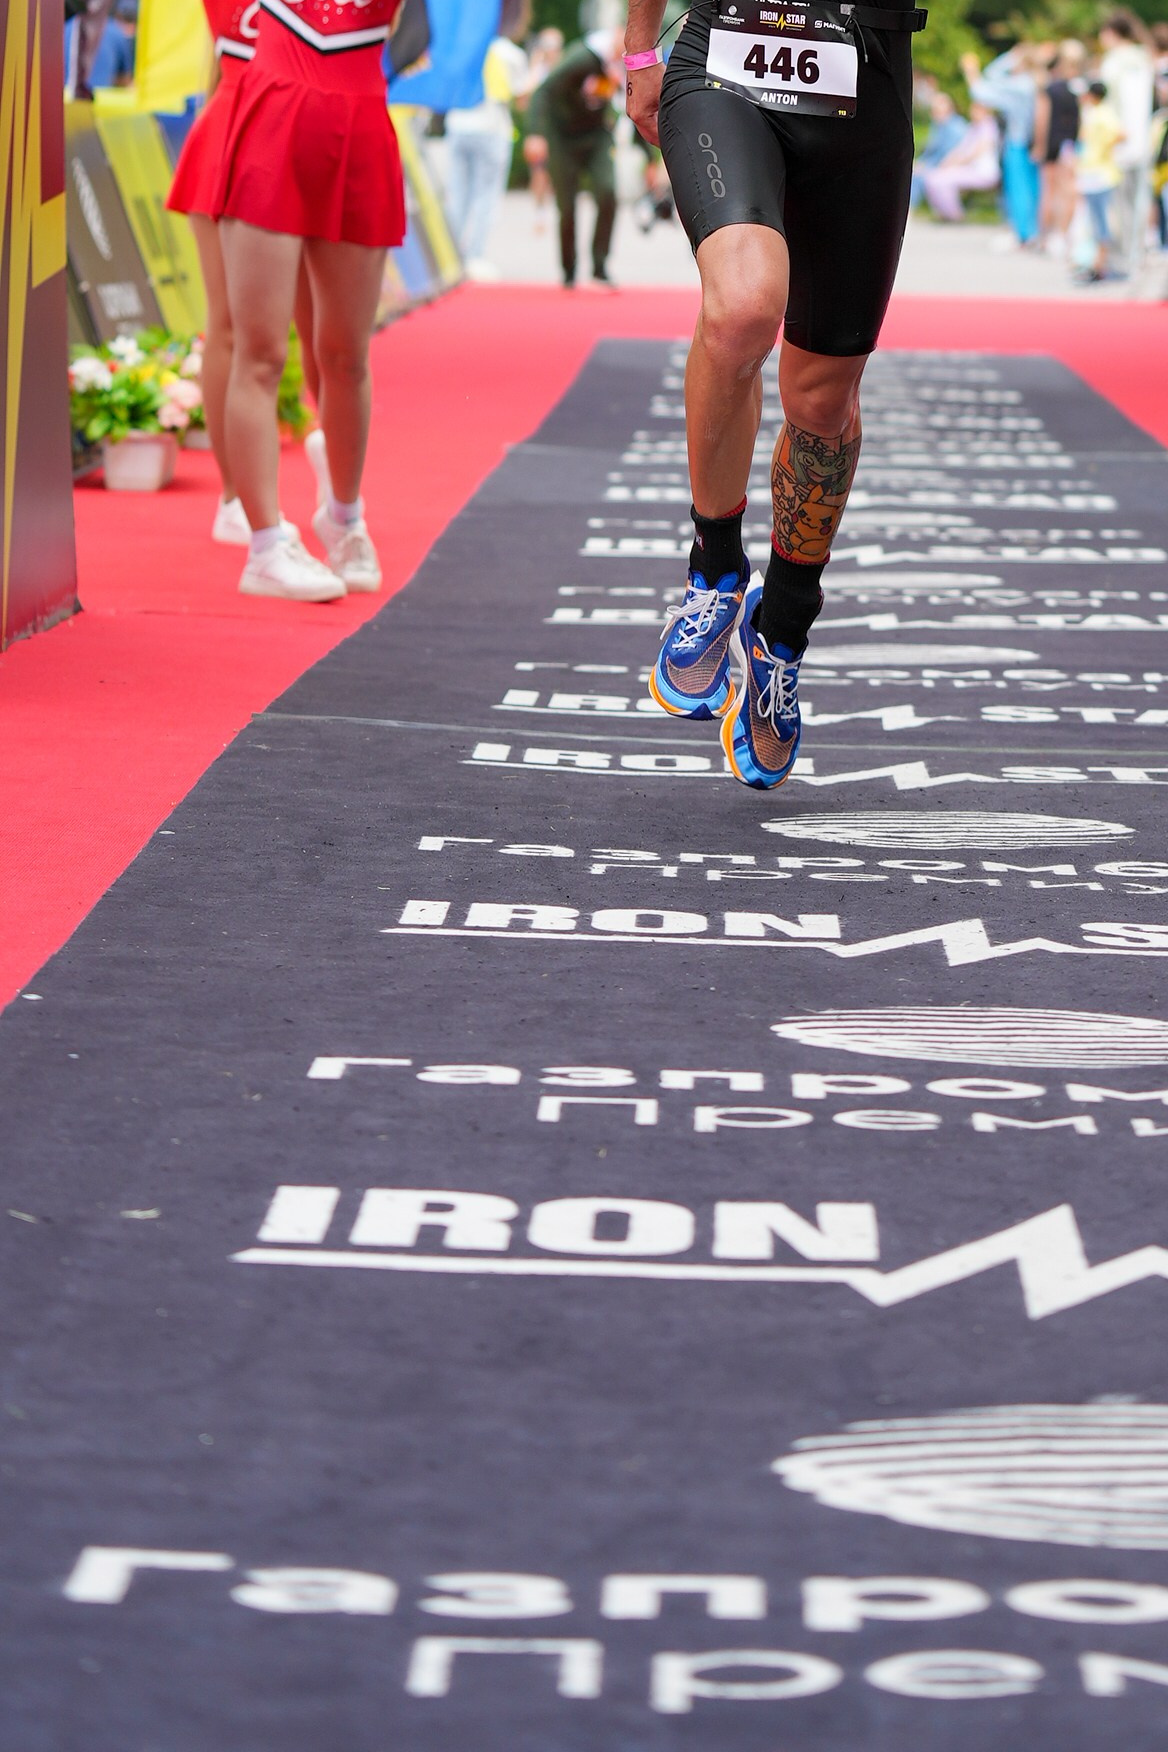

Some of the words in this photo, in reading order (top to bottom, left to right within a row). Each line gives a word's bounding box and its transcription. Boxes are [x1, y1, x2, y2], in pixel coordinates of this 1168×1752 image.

[759, 10, 779, 22] IRON
[785, 13, 806, 25] STAR
[743, 43, 820, 84] 446
[761, 91, 798, 106] ANTON
[697, 132, 726, 198] orca
[398, 899, 842, 939] IRON
[256, 1184, 881, 1262] IRON
